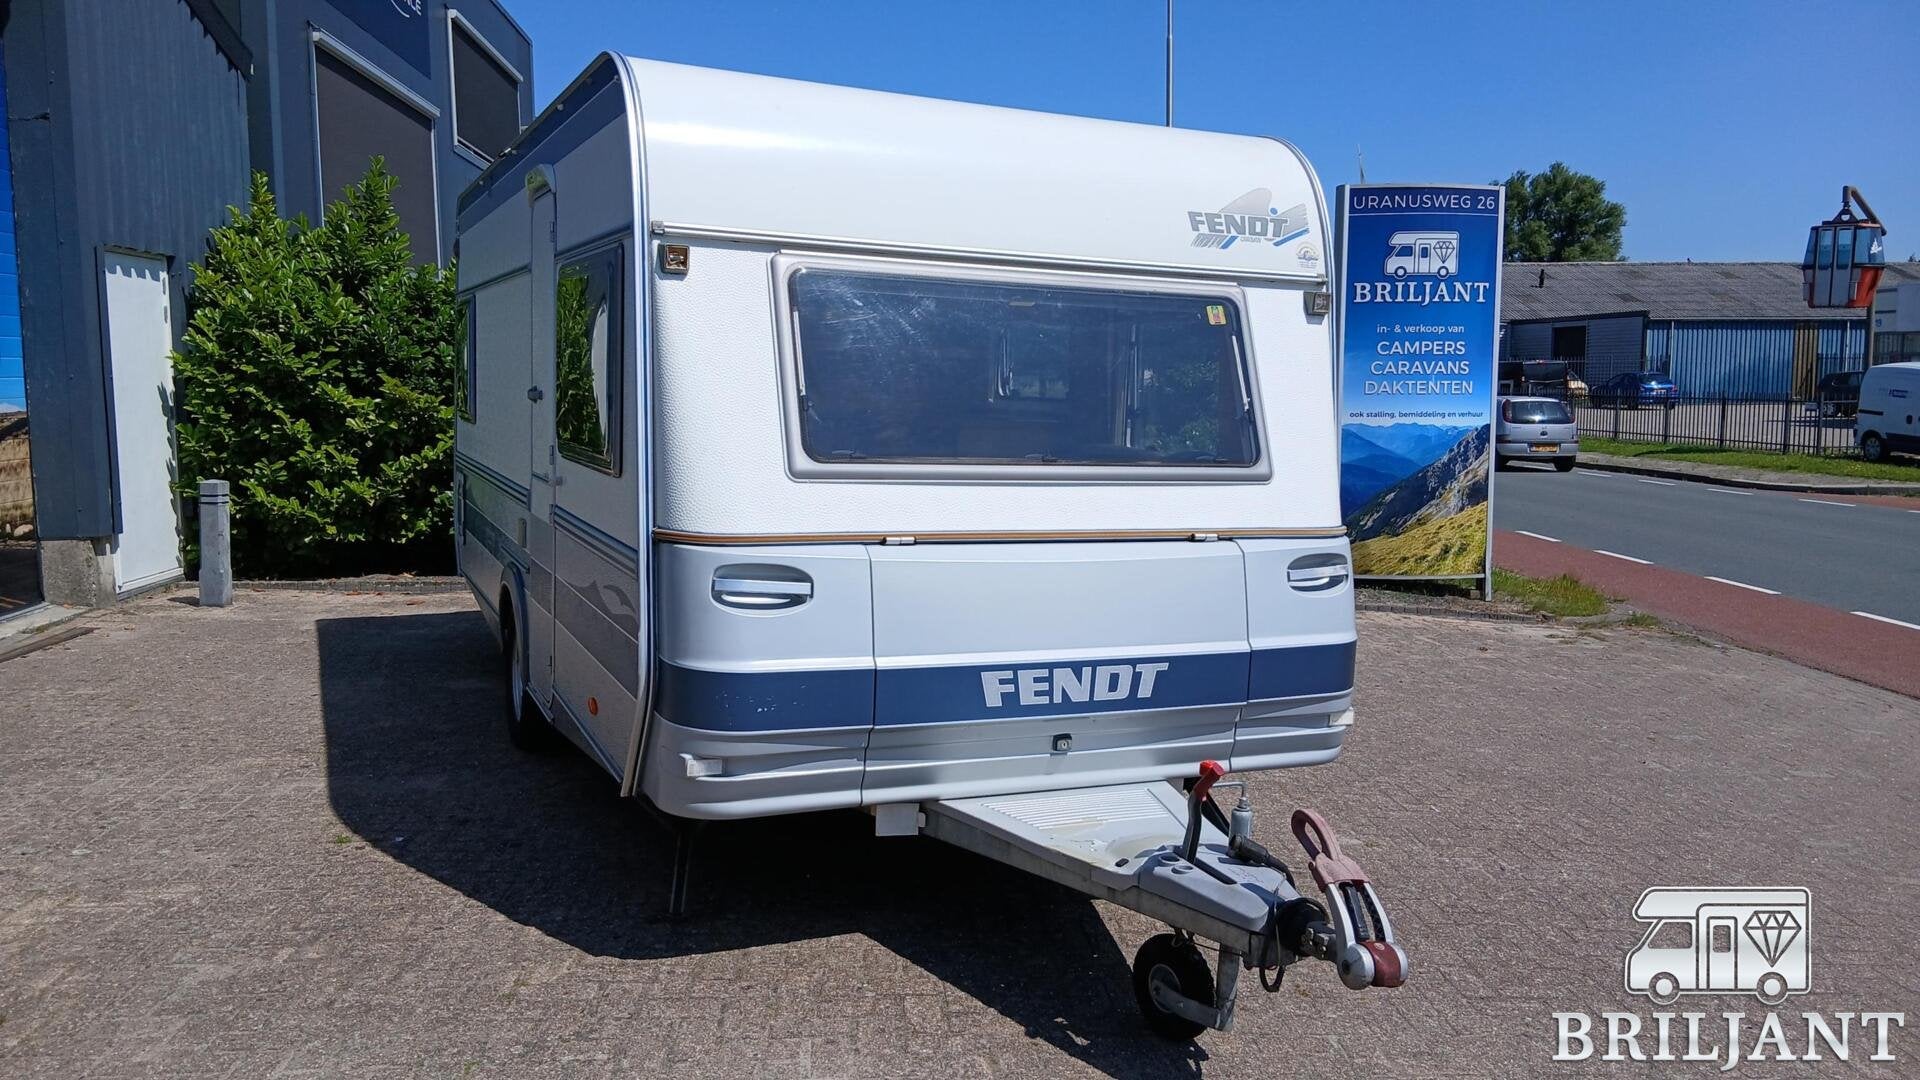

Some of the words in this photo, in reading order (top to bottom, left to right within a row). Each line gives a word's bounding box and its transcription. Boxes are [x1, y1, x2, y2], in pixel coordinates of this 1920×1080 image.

[1353, 194, 1471, 210] URANUSWEG
[1477, 195, 1495, 210] 26
[1187, 211, 1288, 238] FENDT
[1353, 281, 1490, 306] BRILJANT
[1376, 324, 1391, 333] in-
[1393, 324, 1401, 333] &
[1404, 324, 1446, 335] verkoop
[1447, 325, 1465, 333] van
[1376, 340, 1466, 355] CAMPERS
[1370, 360, 1470, 375] CARAVANS
[1364, 380, 1473, 395] DAKTENTEN
[1349, 410, 1364, 418] ook
[1366, 410, 1396, 420] stalling,
[1398, 410, 1446, 419] bemiddeling
[1458, 410, 1484, 418] verhuur
[980, 662, 1170, 708] FENDT
